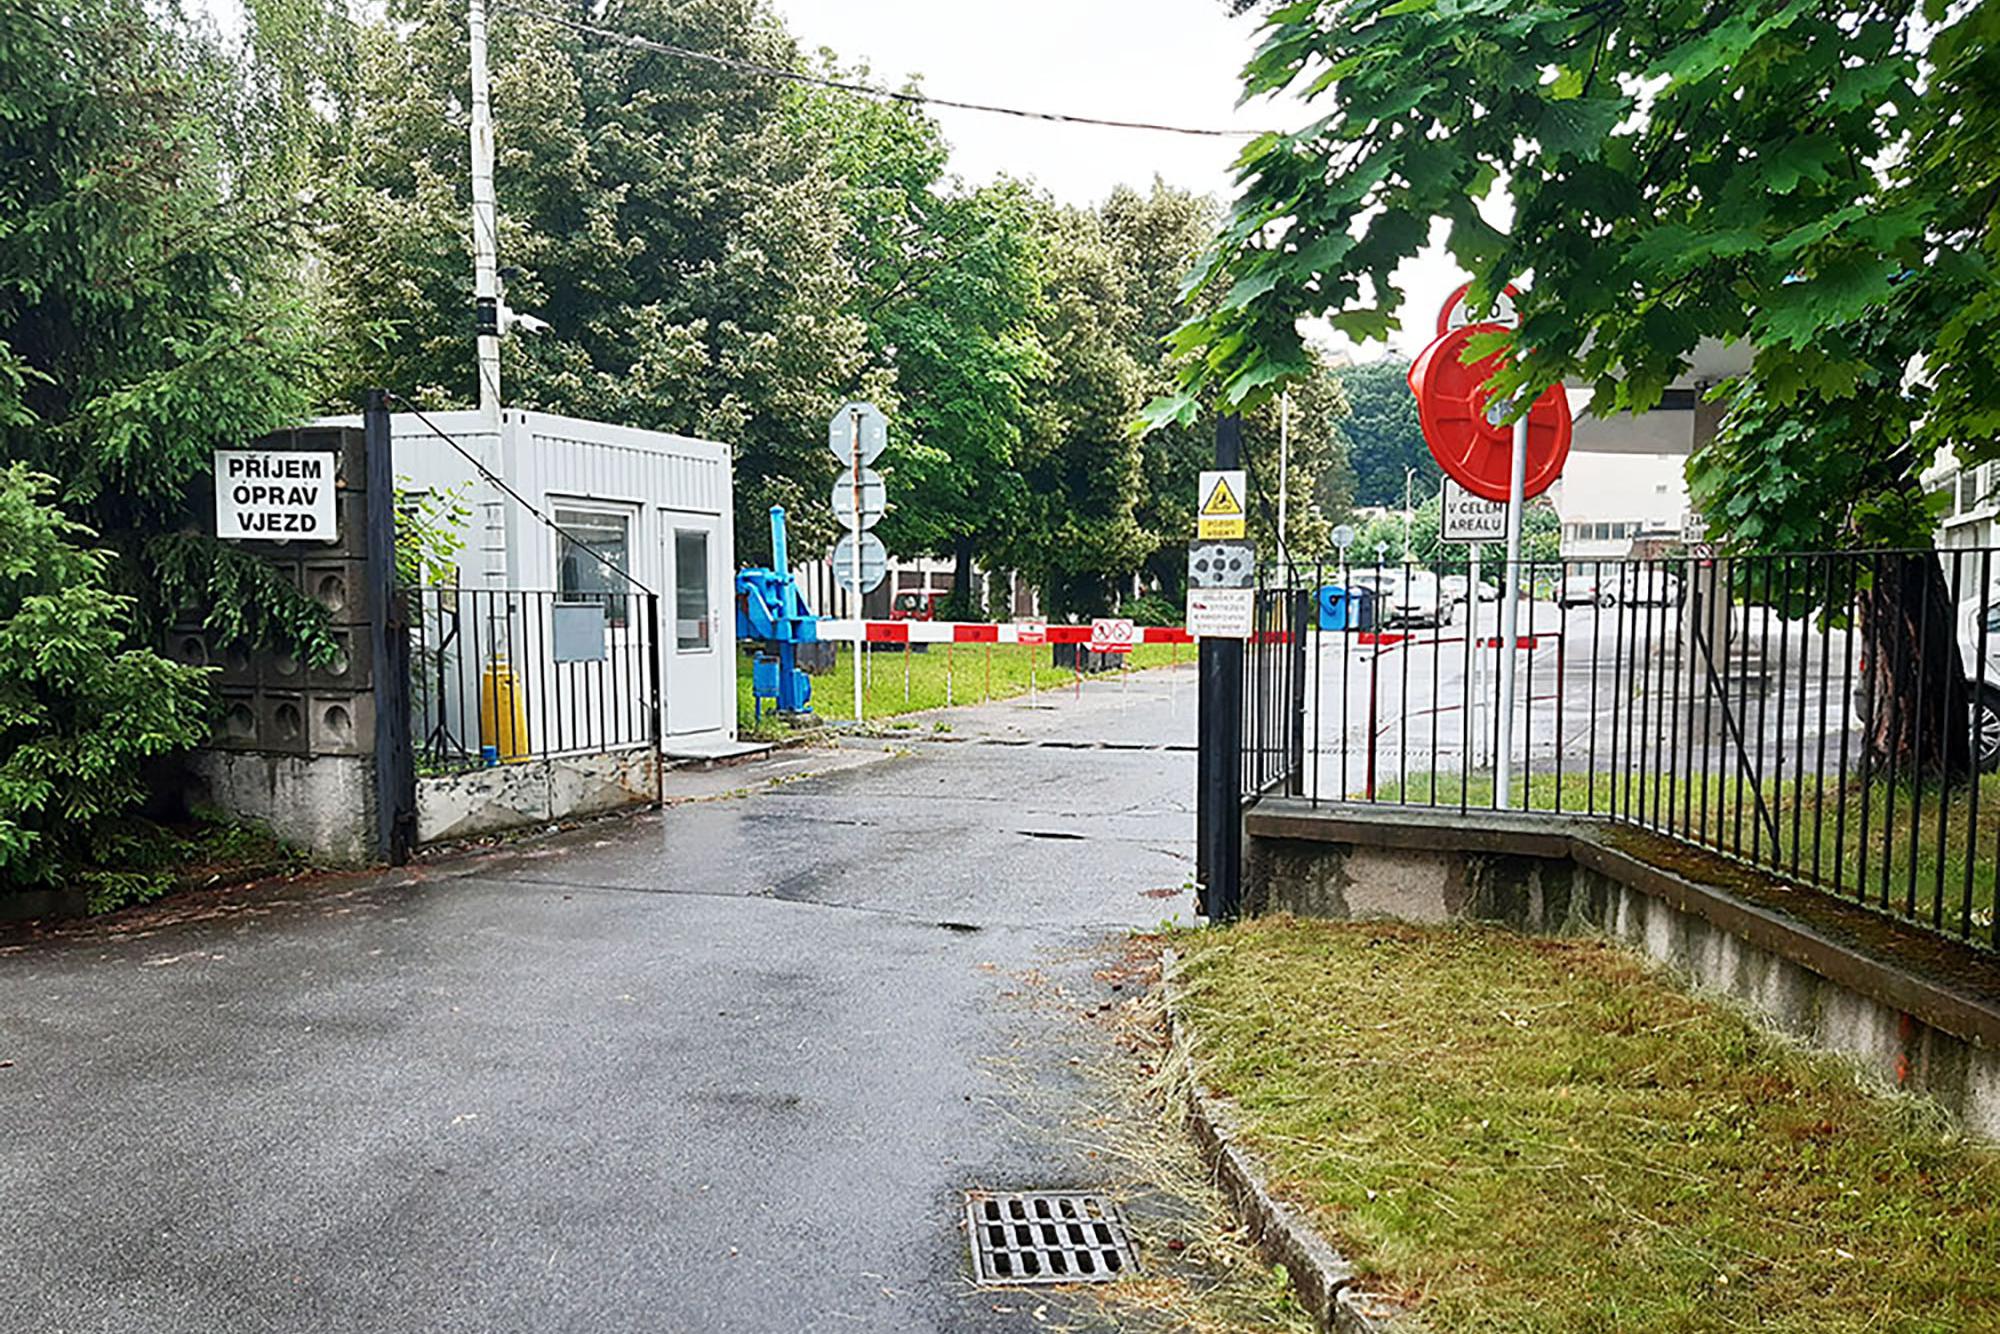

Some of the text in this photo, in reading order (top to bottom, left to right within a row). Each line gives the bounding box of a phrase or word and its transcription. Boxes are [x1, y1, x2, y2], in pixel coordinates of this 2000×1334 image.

[228, 454, 321, 479] PŘÍJEM
[233, 486, 318, 506] OPRAV
[1448, 502, 1457, 514] V
[237, 512, 317, 532] VJEZD
[1449, 517, 1502, 530] AREÁLU
